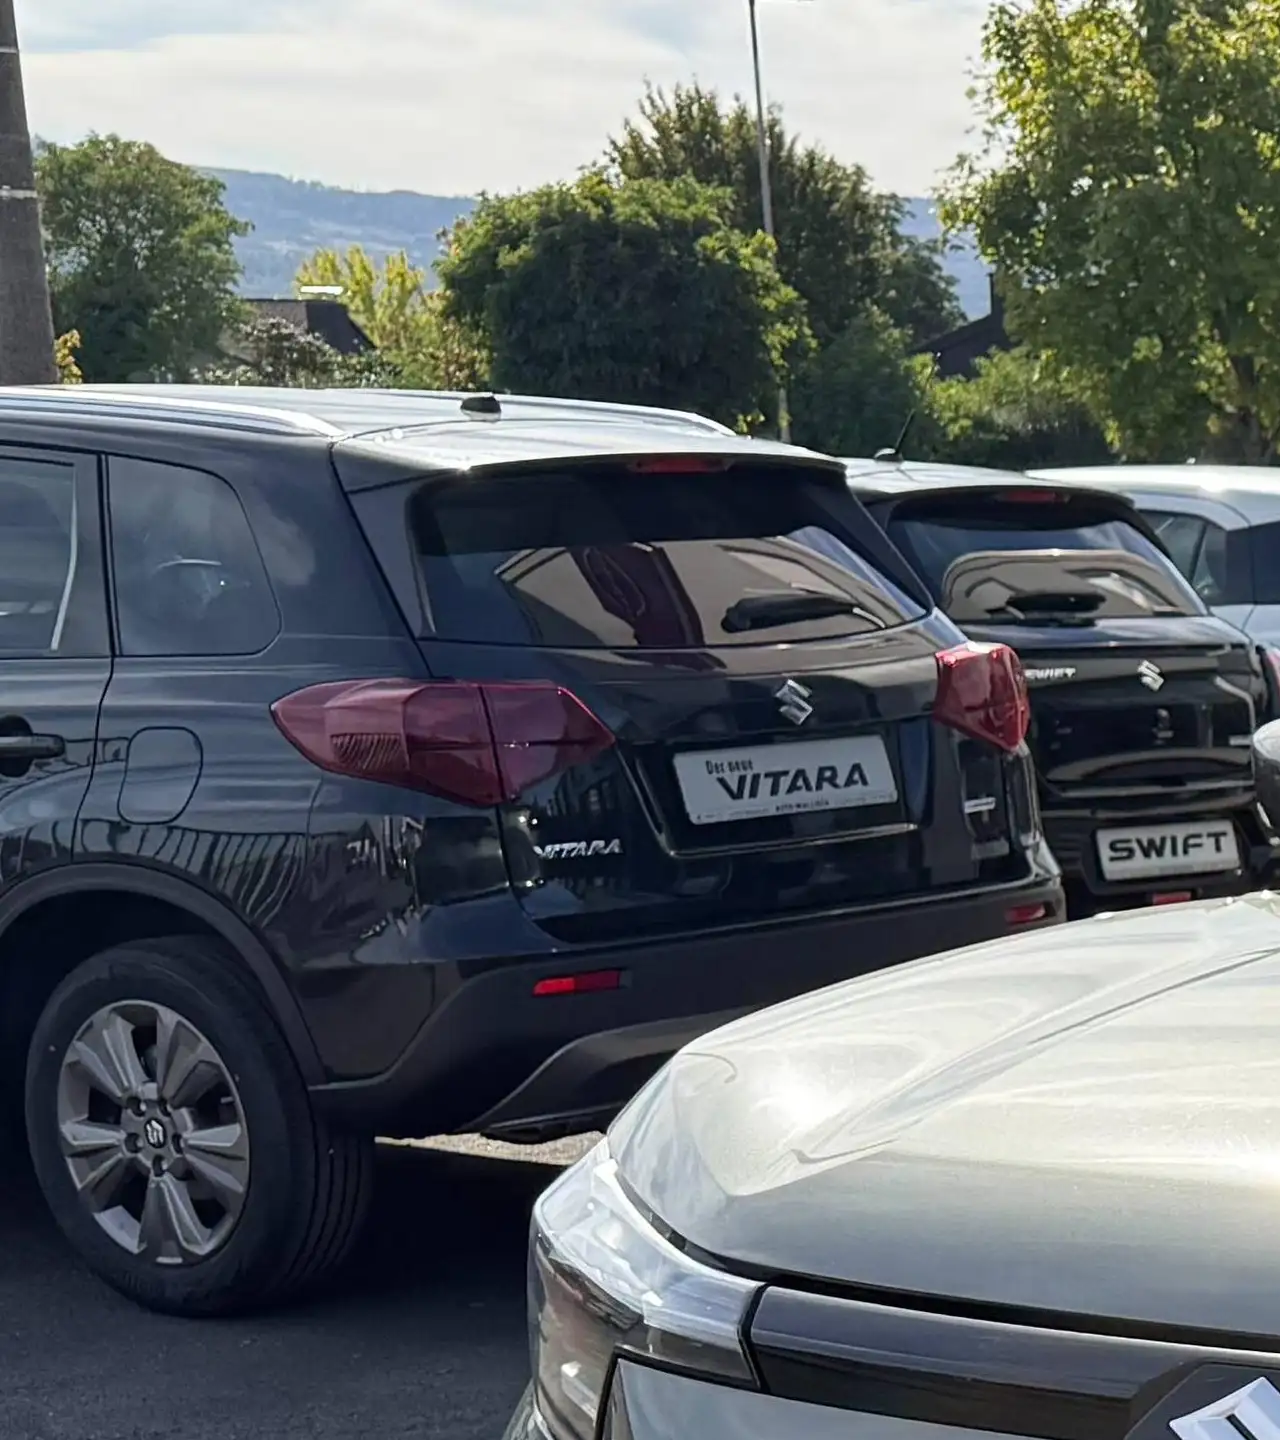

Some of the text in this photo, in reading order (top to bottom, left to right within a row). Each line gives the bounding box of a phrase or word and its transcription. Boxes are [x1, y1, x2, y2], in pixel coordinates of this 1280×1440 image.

[716, 762, 869, 801] VITARA
[533, 838, 623, 859] VITARA
[1108, 830, 1228, 862] SWIFT
